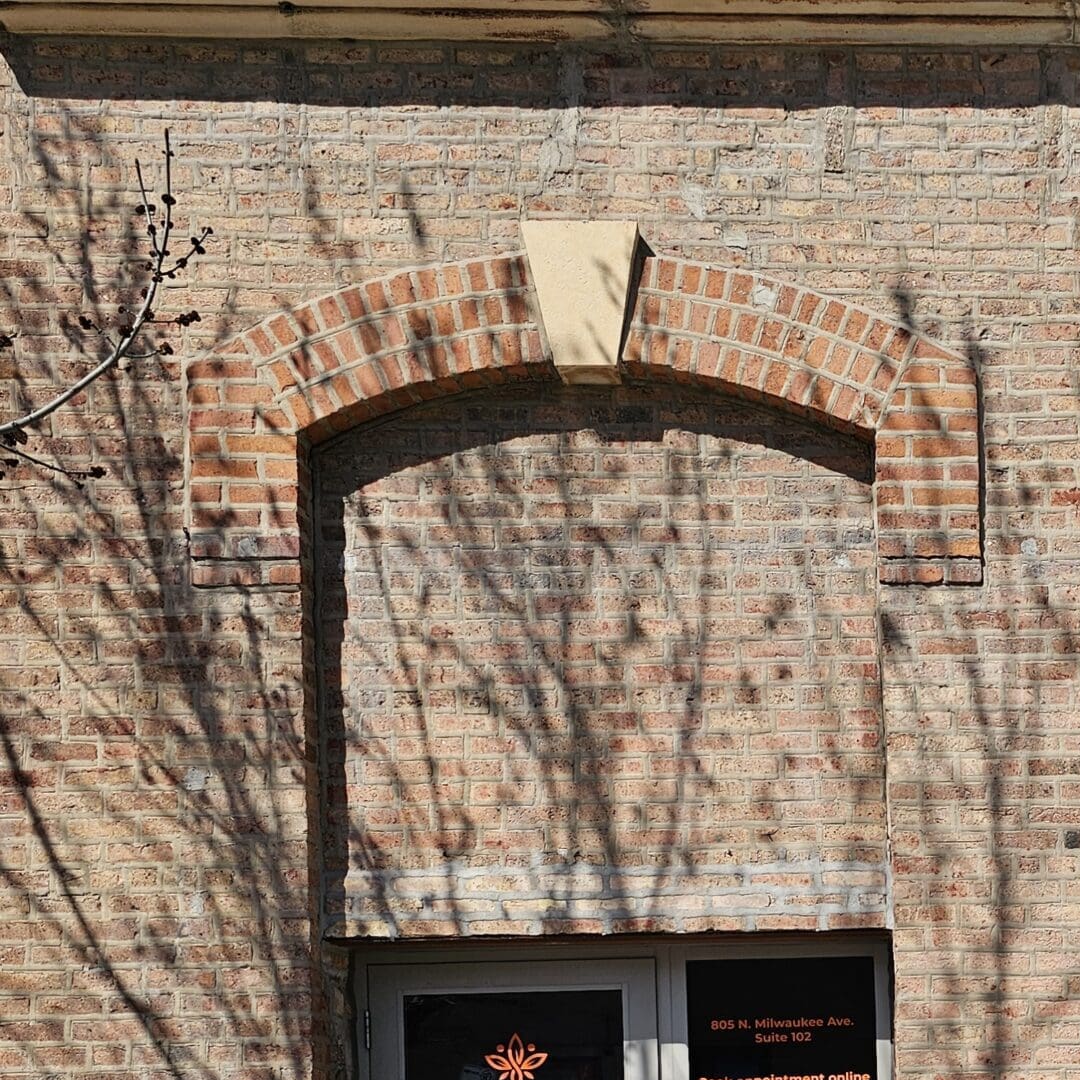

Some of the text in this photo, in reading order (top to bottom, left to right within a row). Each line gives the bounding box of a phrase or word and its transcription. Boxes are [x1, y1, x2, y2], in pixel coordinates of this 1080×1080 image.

[711, 1016, 854, 1031] 805 N. Milwaukee Ave.
[754, 1031, 812, 1043] Suite 102
